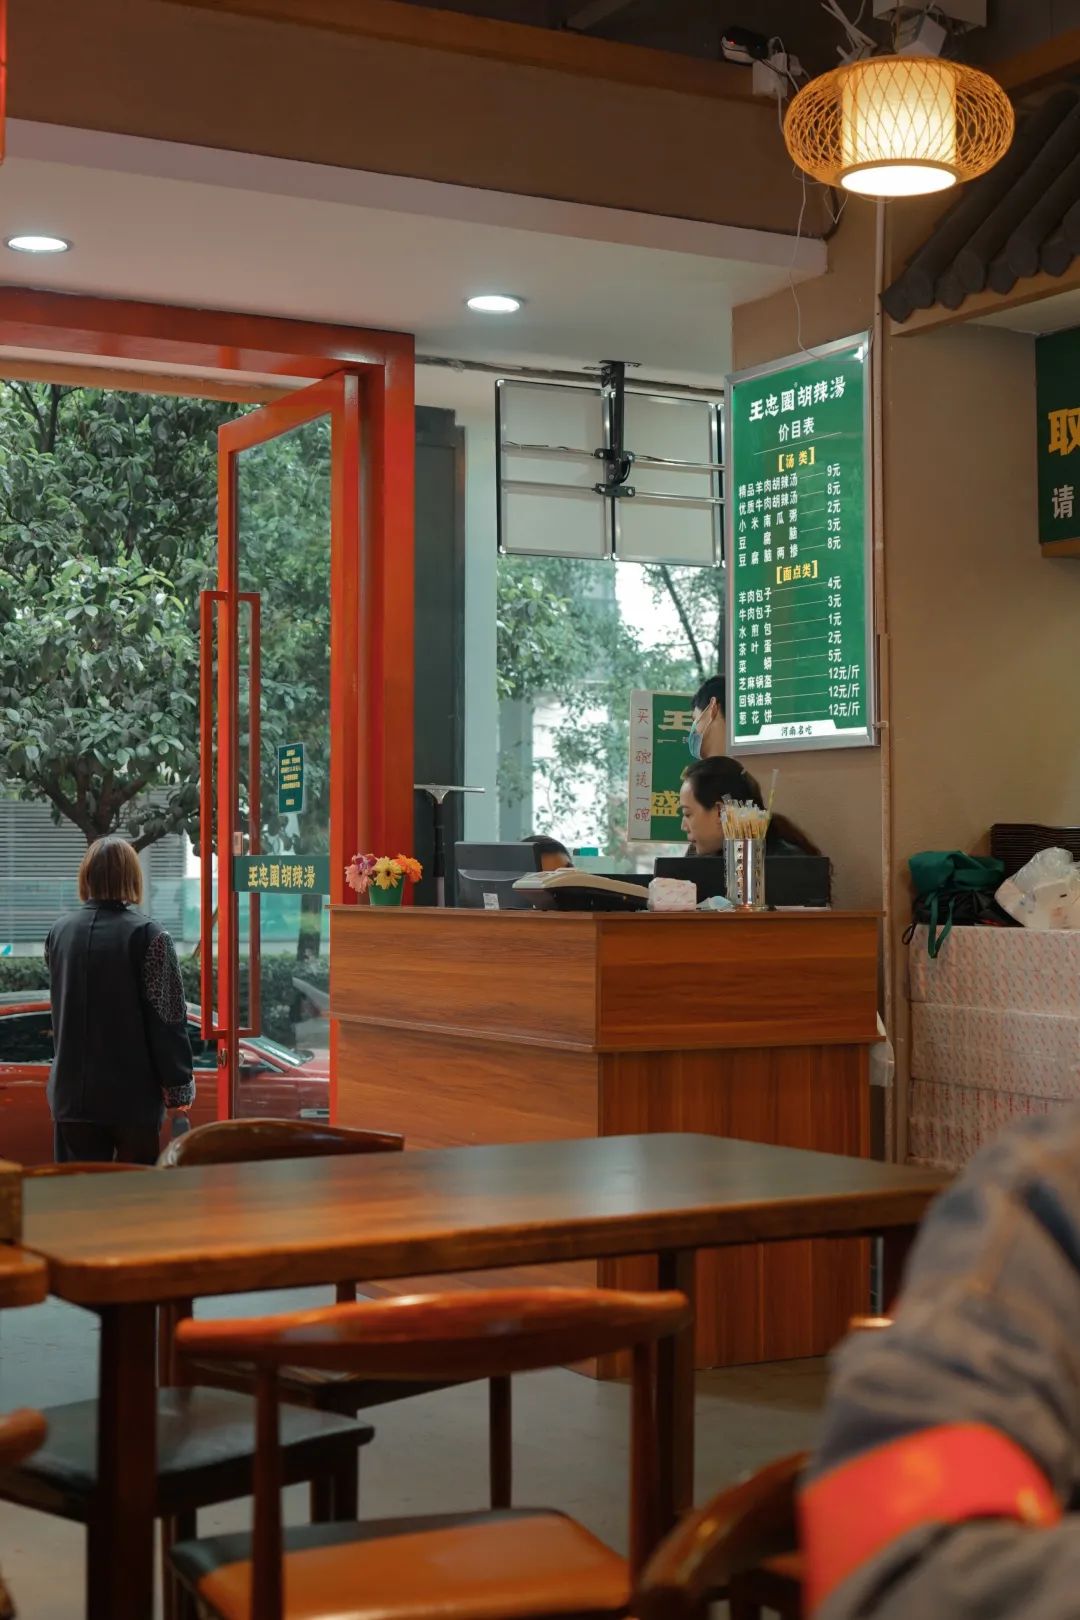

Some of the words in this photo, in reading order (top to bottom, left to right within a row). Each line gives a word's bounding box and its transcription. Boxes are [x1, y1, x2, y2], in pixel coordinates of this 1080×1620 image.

[778, 417, 815, 442] 价目表
[739, 473, 798, 498] 精品羊肉胡辣汤
[827, 463, 841, 477] 9元
[739, 491, 798, 516] 优质牛肉胡辣汤
[827, 481, 841, 495] 8元
[827, 499, 841, 513] 2元
[1052, 484, 1074, 519] 请
[827, 518, 841, 532] 3元
[827, 536, 841, 550] 8元
[739, 587, 772, 605] 羊肉包子
[827, 576, 842, 590] 4元
[739, 605, 772, 622] 牛肉包子
[828, 594, 842, 608] 3元
[739, 623, 772, 639] 水煎包
[828, 612, 842, 626] 1元
[739, 640, 772, 656] 茶叶蛋
[828, 630, 842, 644] 2元
[828, 649, 842, 663] 5元
[829, 665, 860, 680] 12元/斤
[739, 692, 772, 708] 回锅油条
[829, 683, 860, 698] 12元/斤
[829, 701, 860, 717] 12元/斤
[781, 725, 813, 737] 河南名吃
